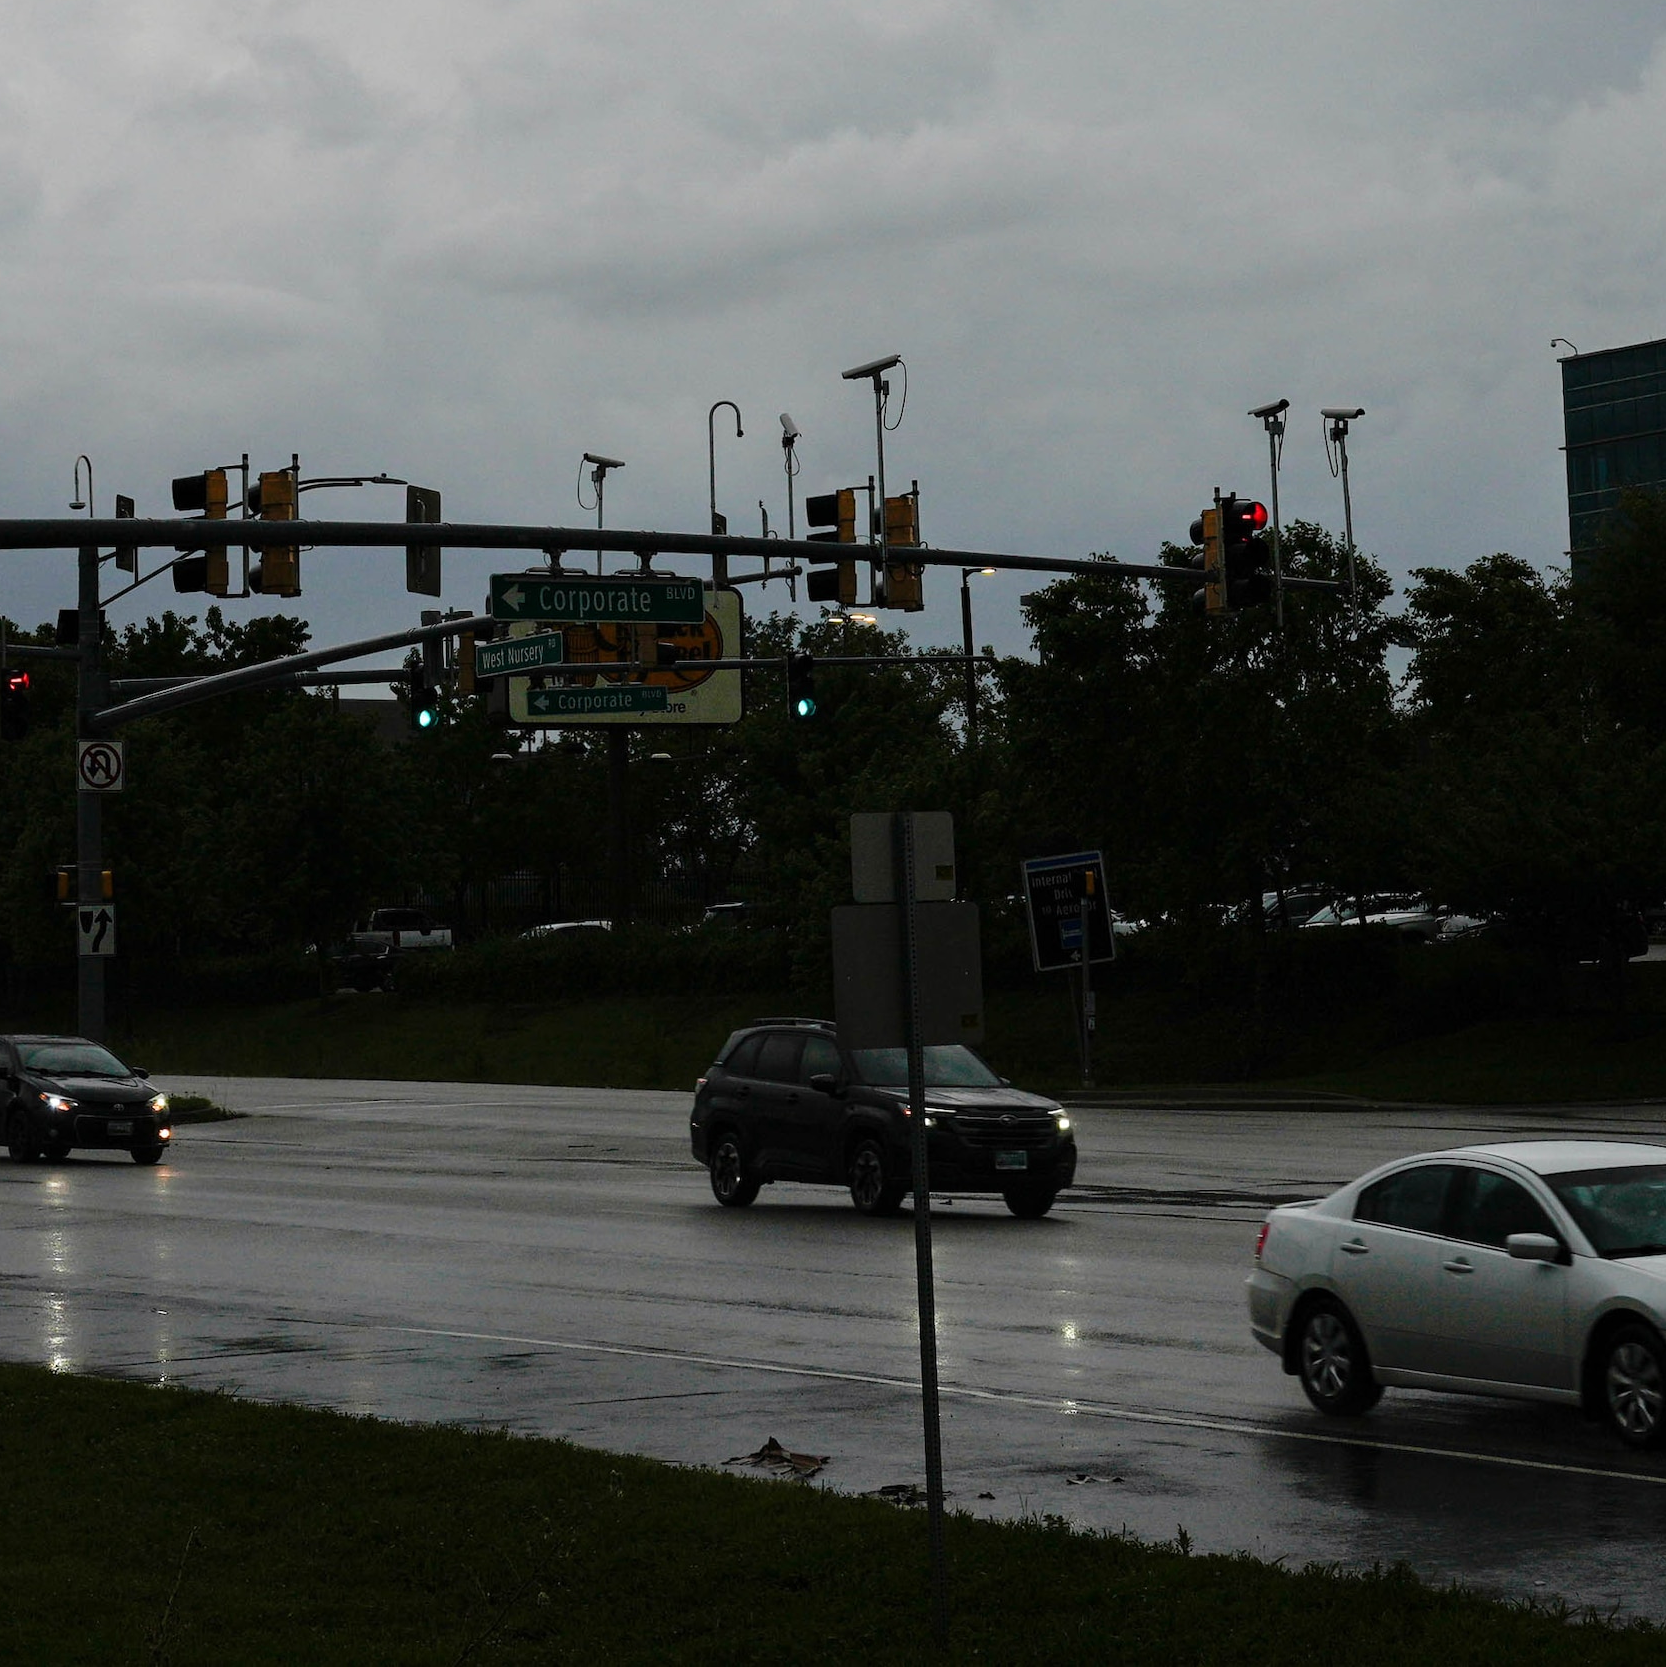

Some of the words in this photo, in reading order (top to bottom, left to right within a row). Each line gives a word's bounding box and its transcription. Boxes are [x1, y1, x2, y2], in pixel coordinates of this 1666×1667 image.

[538, 585, 652, 617] Corporate
[665, 586, 696, 600] BLVD
[482, 648, 505, 669] West
[507, 643, 544, 665] Nursery
[558, 693, 632, 713] Corporate
[641, 690, 662, 700] BLVD
[1031, 871, 1072, 888] Internal
